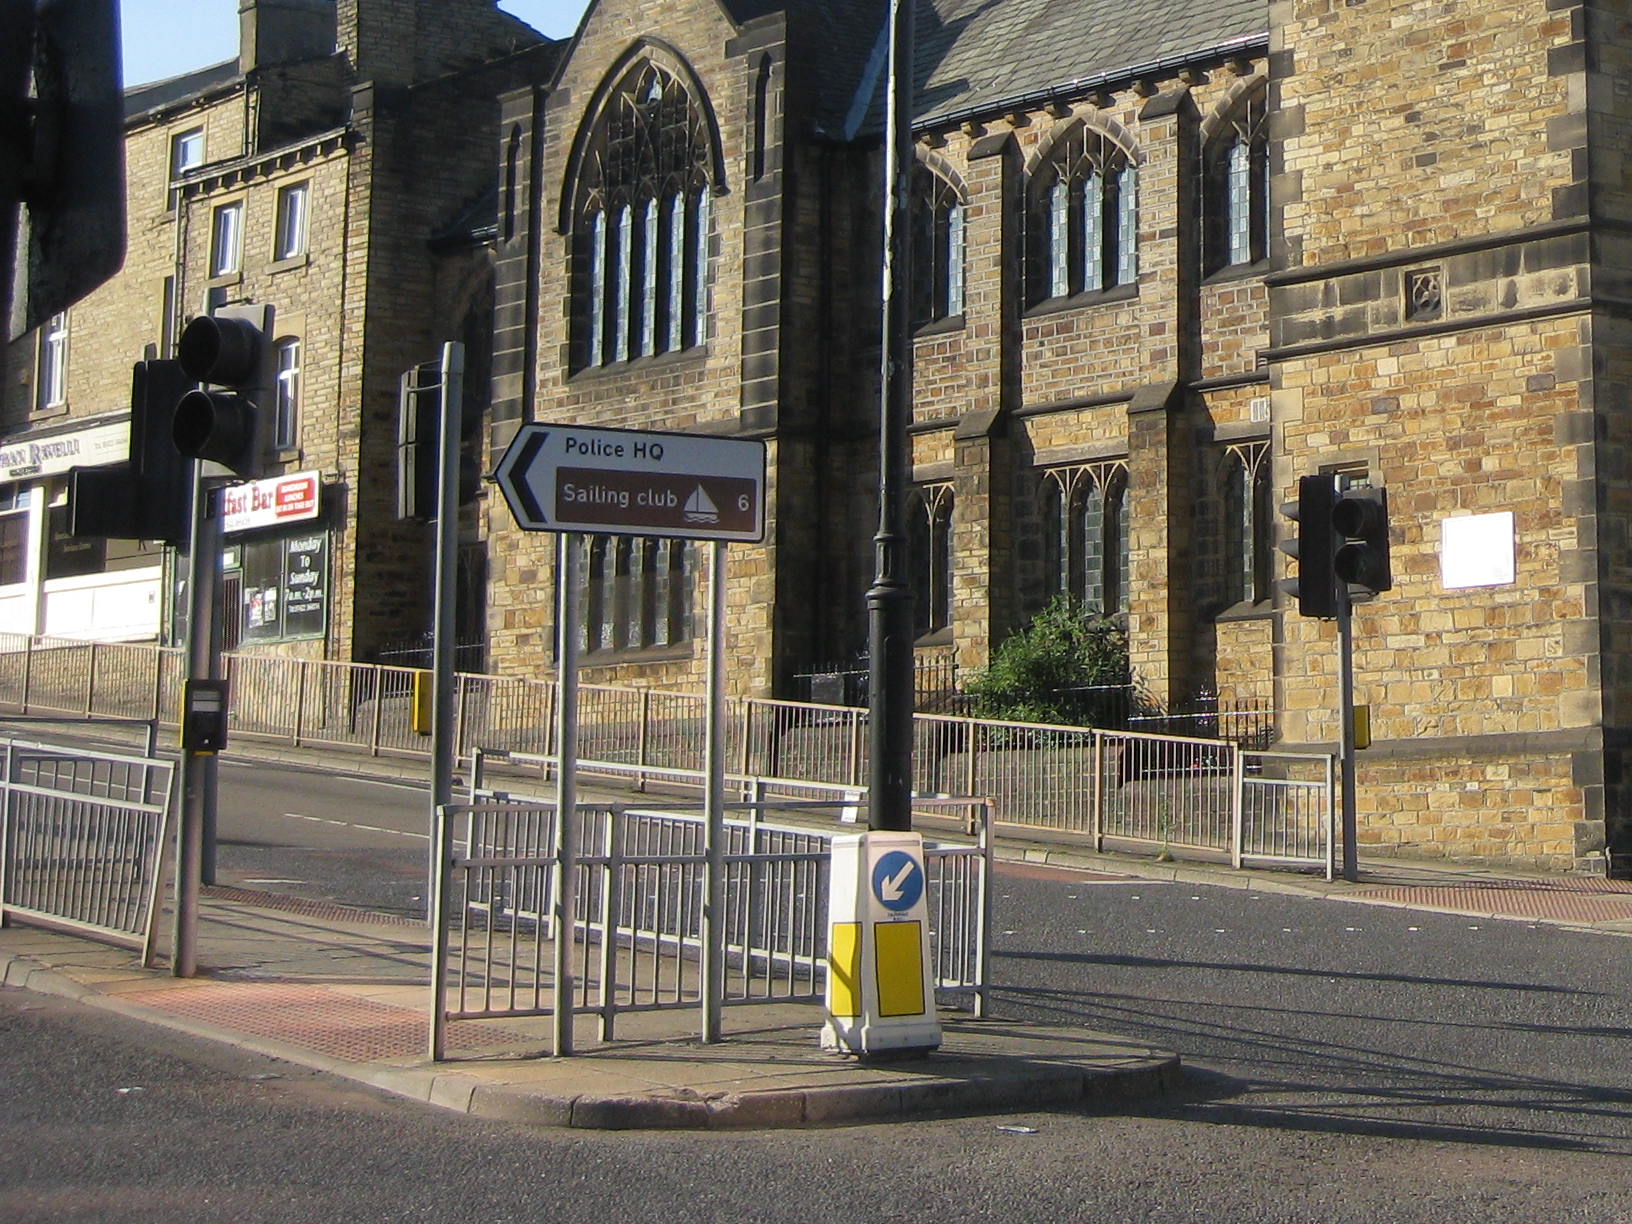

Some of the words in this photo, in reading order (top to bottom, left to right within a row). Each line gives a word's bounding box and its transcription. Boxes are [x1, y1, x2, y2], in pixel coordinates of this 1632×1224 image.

[565, 436, 624, 457] Police
[633, 442, 664, 461] HQ
[224, 490, 248, 516] fast
[251, 487, 273, 512] Bar
[563, 483, 630, 508] Sailing
[637, 489, 678, 508] club
[737, 494, 749, 512] 6
[289, 537, 322, 553] Monday
[300, 555, 311, 568] To
[289, 569, 320, 586] Sunday
